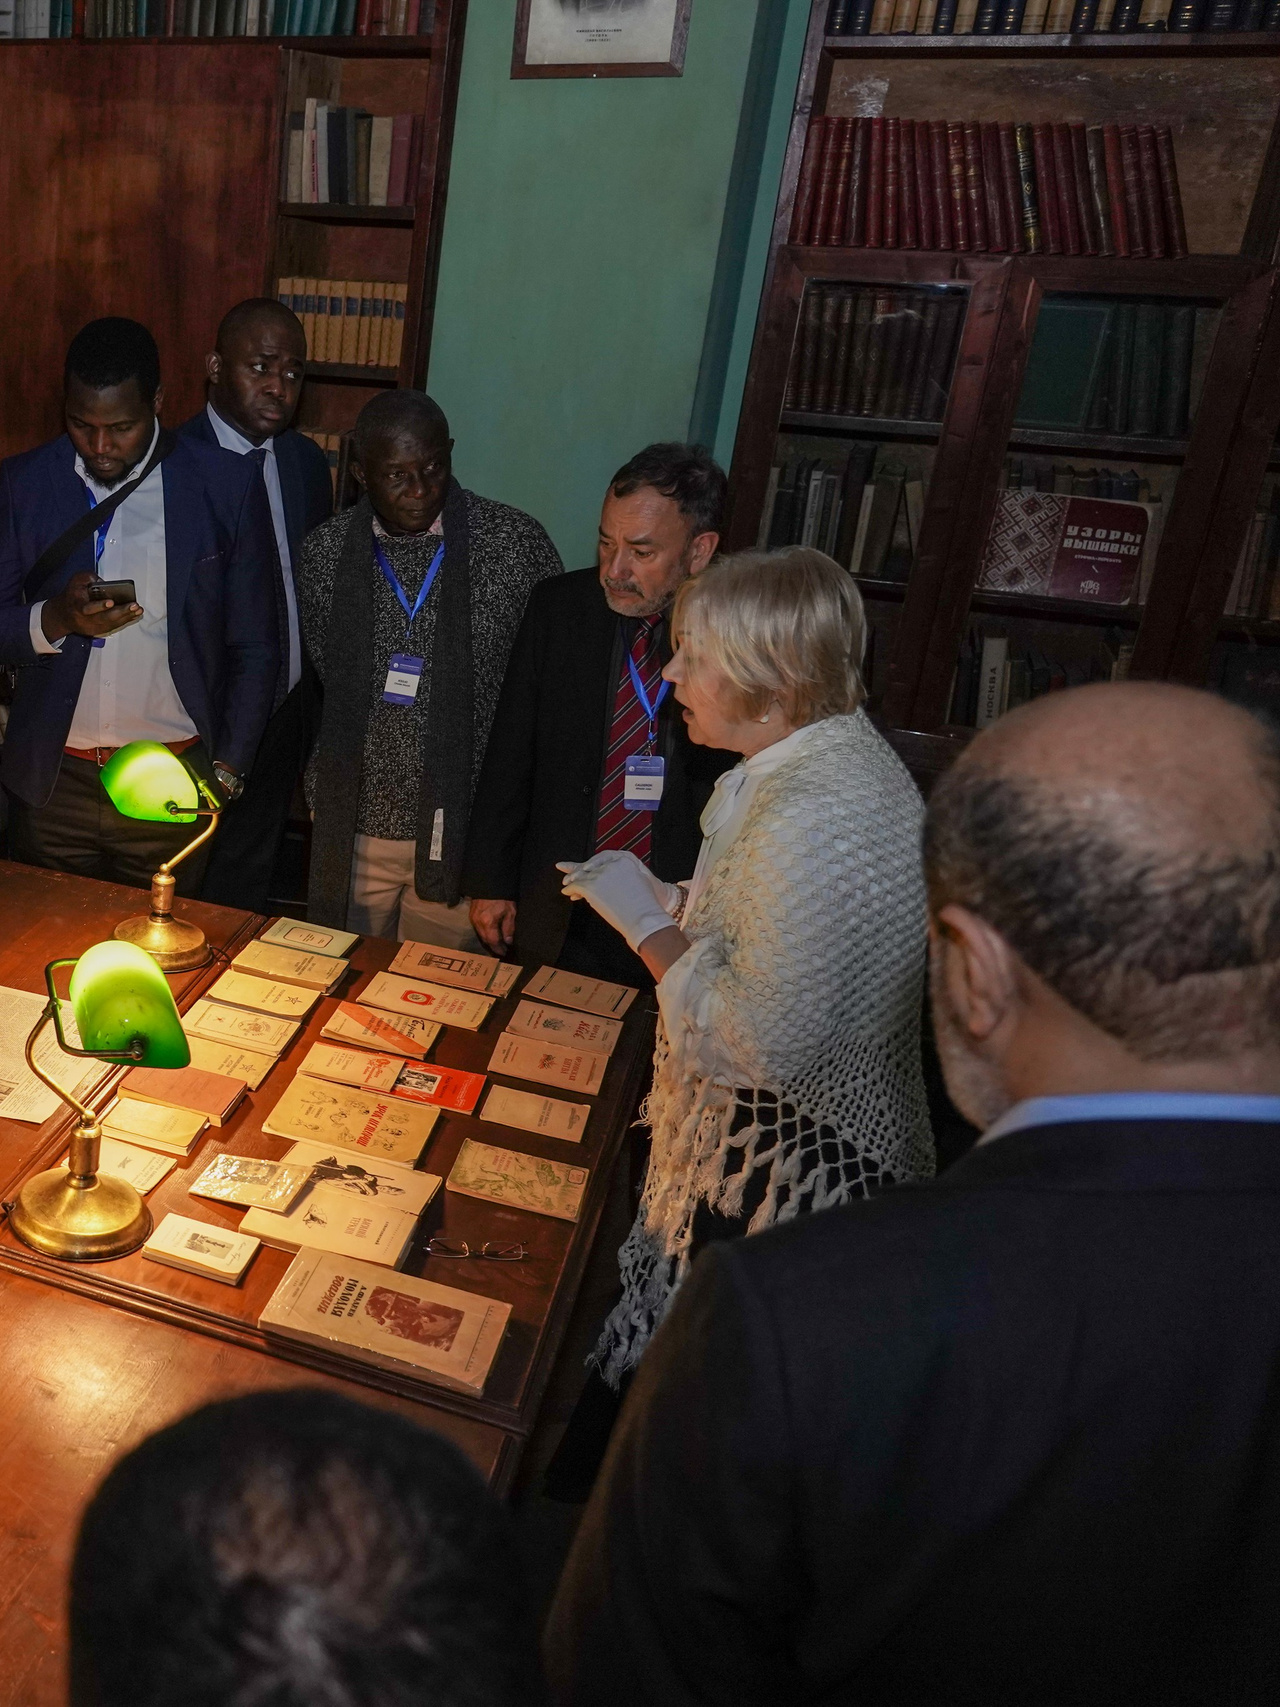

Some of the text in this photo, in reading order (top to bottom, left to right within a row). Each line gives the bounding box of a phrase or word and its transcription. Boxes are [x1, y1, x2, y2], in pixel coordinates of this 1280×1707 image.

[1065, 525, 1142, 544] УЗОРЫ
[1062, 538, 1140, 556] ВЫШИВКИ
[986, 668, 996, 718] МОСКВА
[559, 1057, 573, 1074] БИТВА
[370, 1103, 388, 1119] УРОК
[314, 1273, 346, 1315] гвардия
[329, 1277, 360, 1317] МОЛОДАЯ
